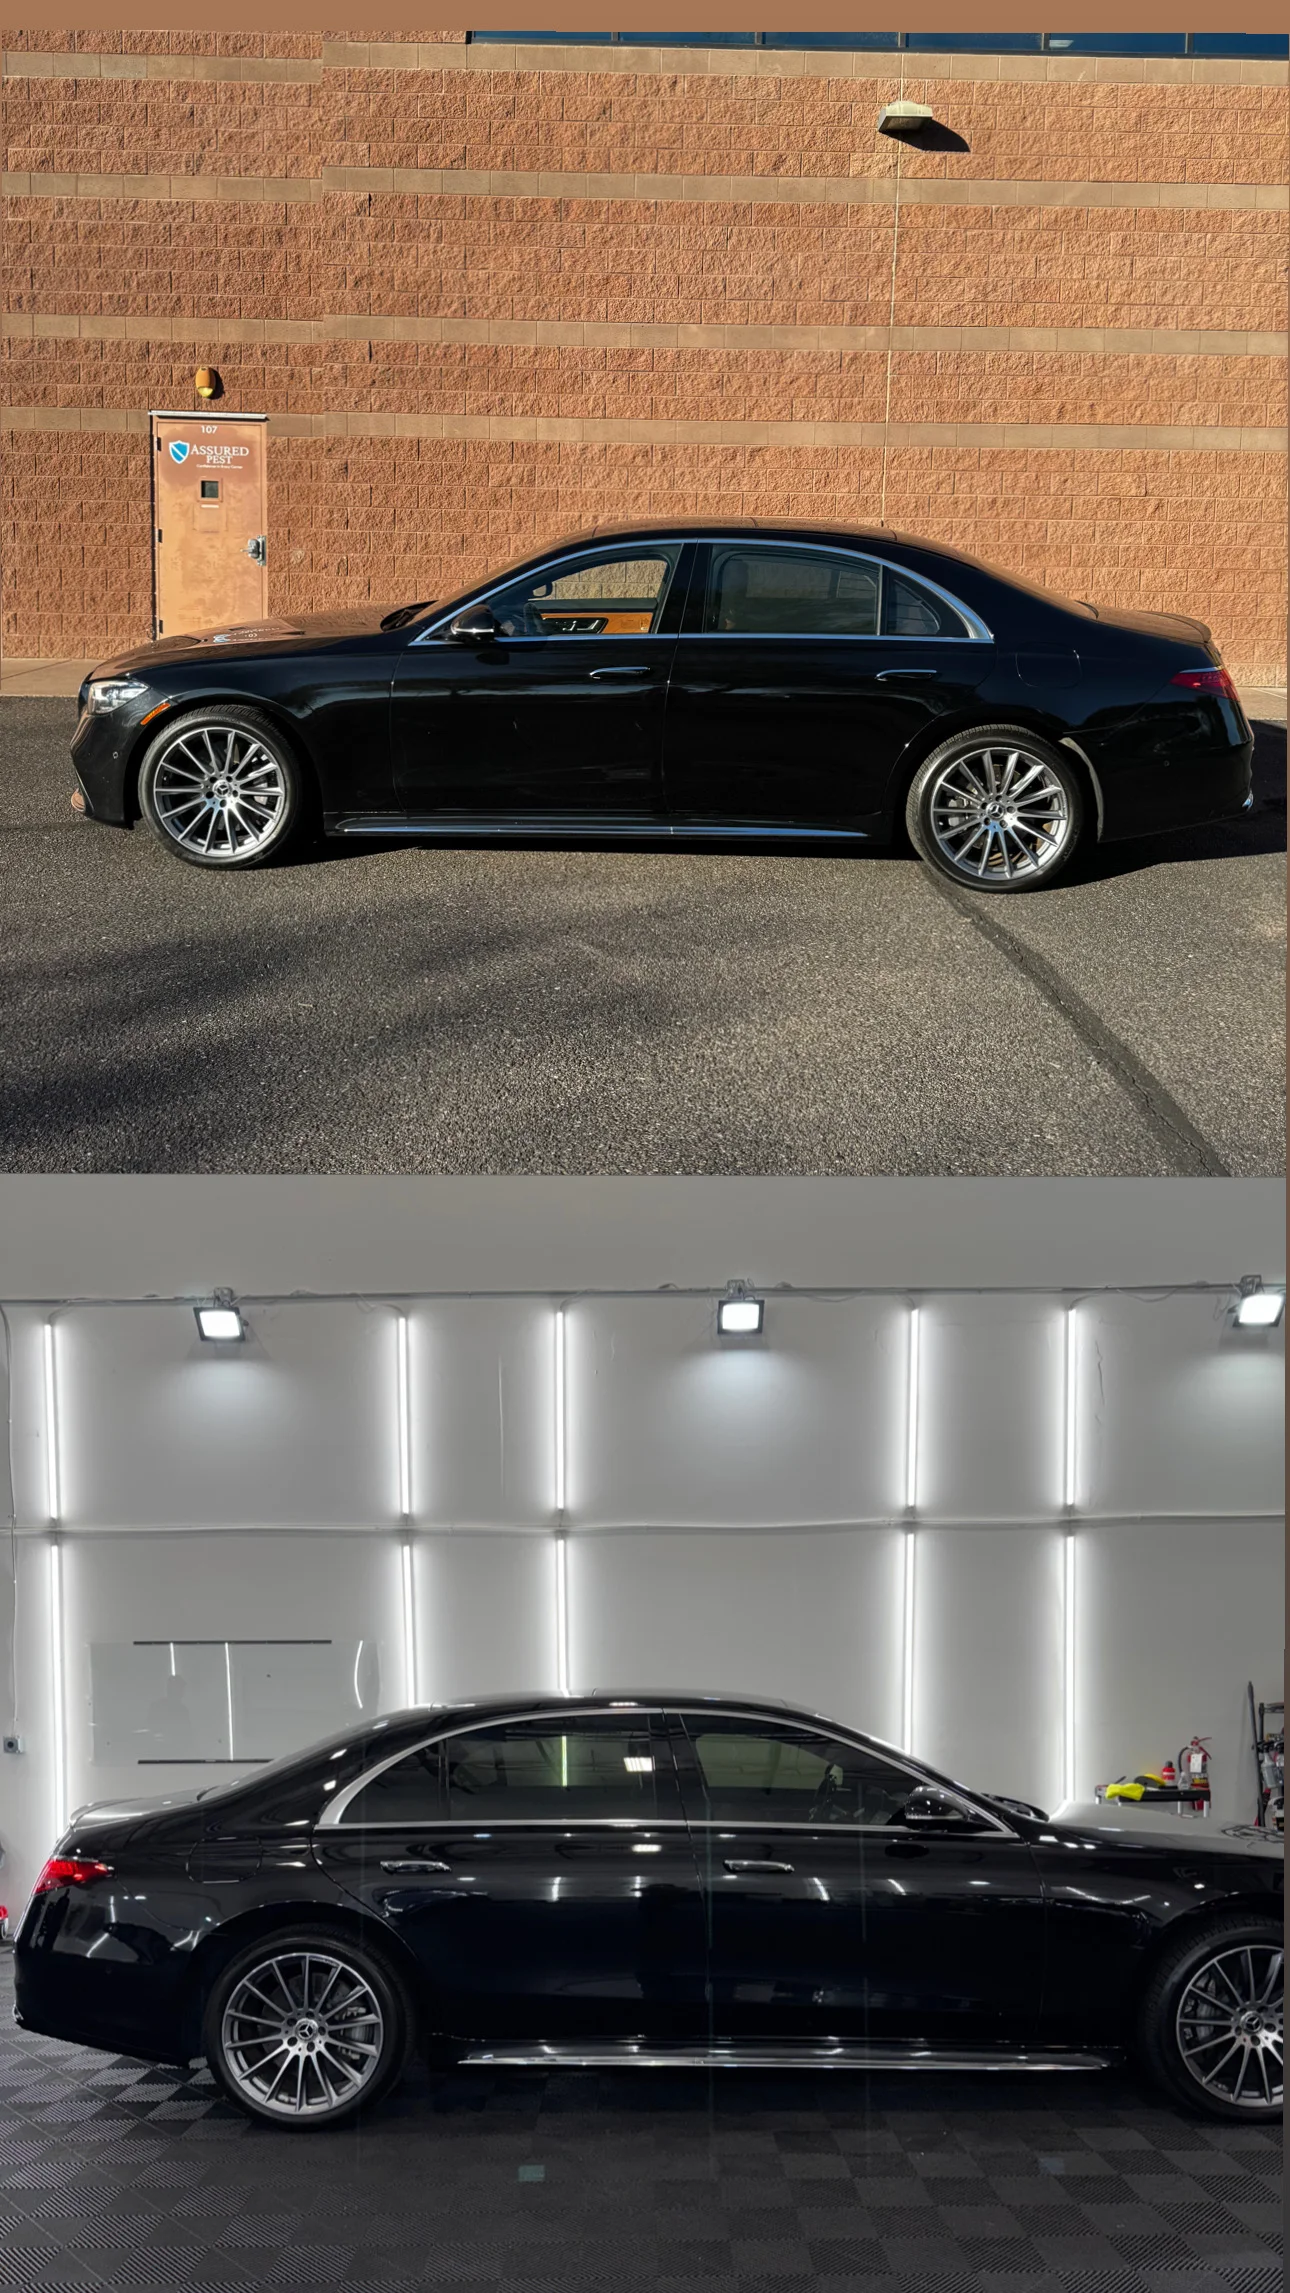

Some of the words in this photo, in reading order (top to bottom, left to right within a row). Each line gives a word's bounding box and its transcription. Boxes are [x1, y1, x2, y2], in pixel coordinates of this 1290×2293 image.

[201, 425, 218, 434] 107
[190, 444, 249, 456] ASSURED
[206, 455, 233, 464] PEST
